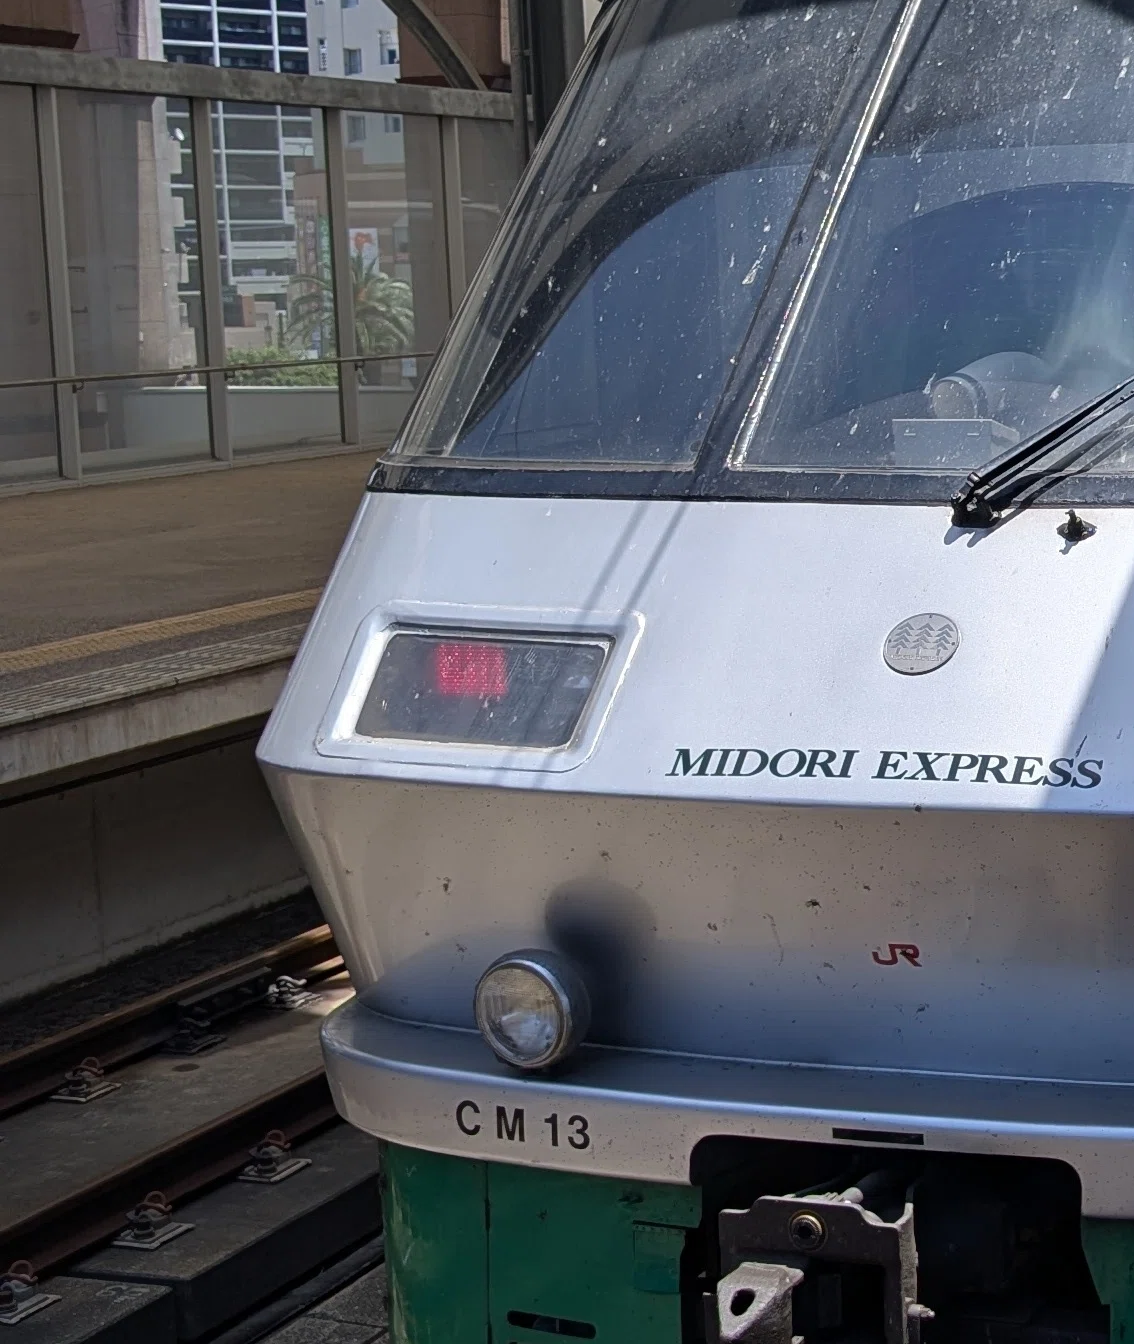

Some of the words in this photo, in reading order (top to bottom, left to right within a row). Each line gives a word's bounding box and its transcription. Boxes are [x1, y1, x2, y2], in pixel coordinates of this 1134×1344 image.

[665, 748, 859, 779] MIDORI
[871, 750, 1104, 789] EXPRESS
[872, 943, 923, 968] JR
